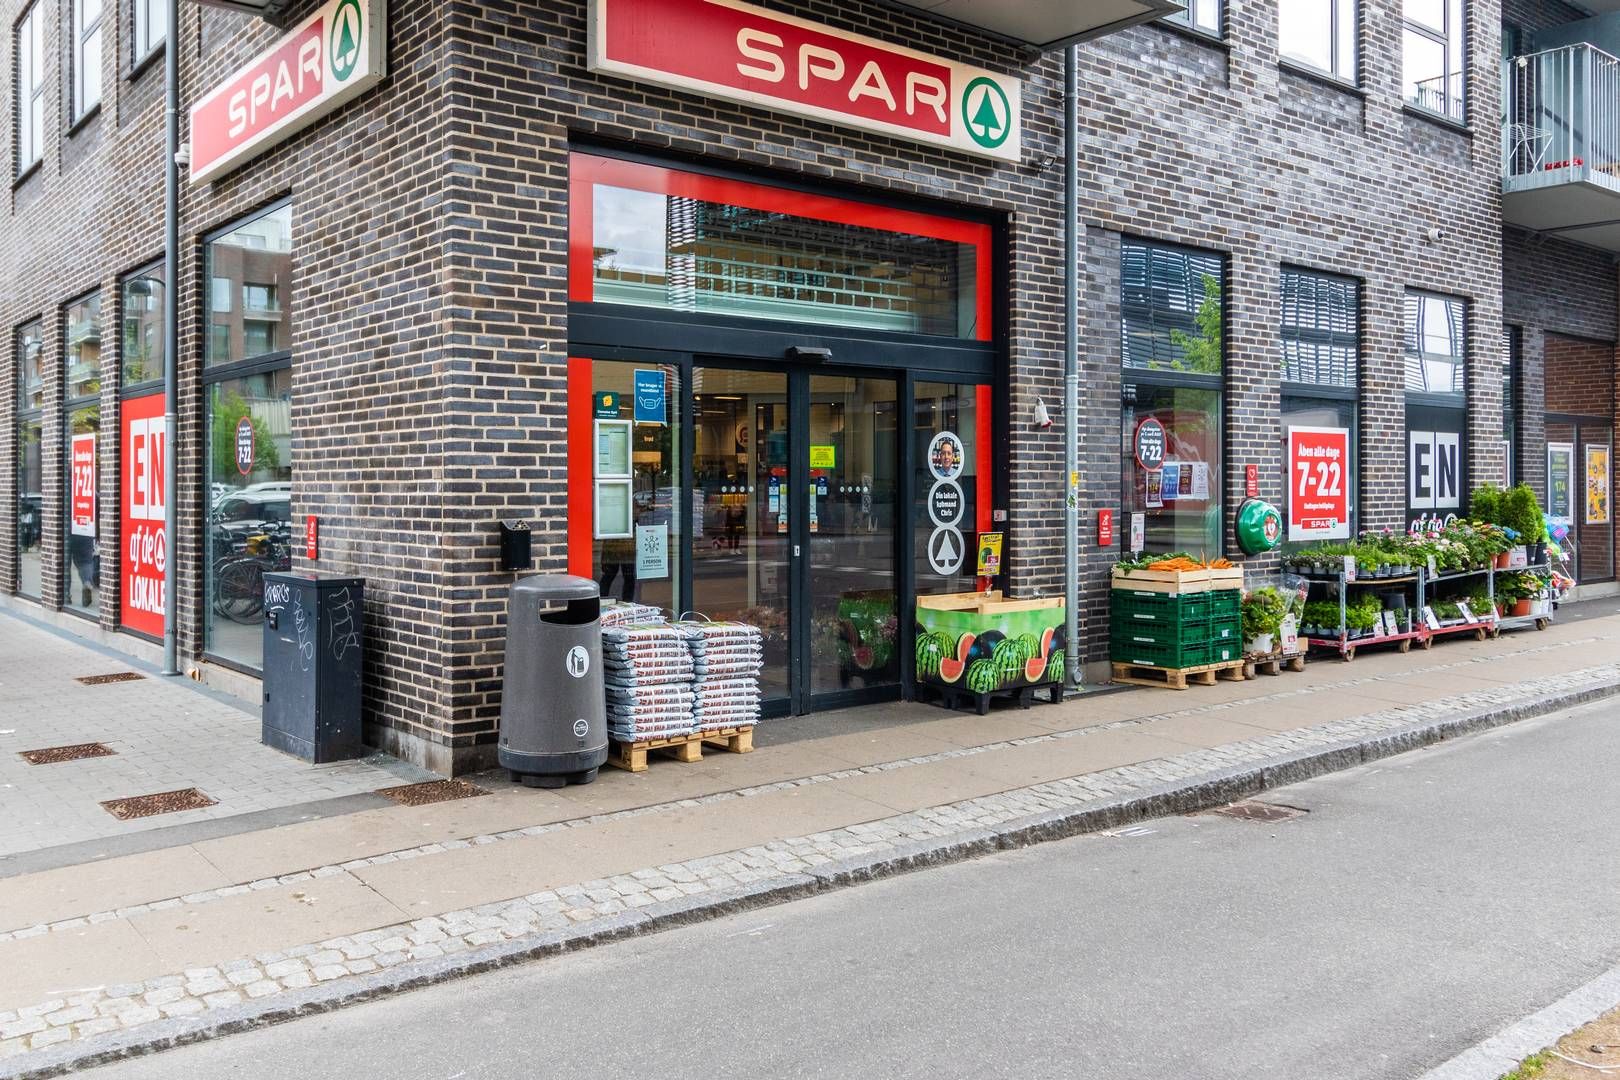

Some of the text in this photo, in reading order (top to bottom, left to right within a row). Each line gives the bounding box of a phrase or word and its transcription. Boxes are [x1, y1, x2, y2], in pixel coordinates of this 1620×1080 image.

[227, 34, 322, 139] SPAR
[736, 26, 947, 124] SPAR
[132, 426, 166, 511] EN
[238, 446, 252, 464] 7-22
[1141, 445, 1162, 461] 7-22
[1298, 442, 1341, 461] Åben alle dage
[75, 464, 93, 497] 7-22
[1297, 461, 1341, 497] 7-22
[1413, 438, 1457, 502] EN
[940, 508, 953, 516] Chris
[1310, 519, 1331, 528] SPAR
[130, 524, 154, 573] af de
